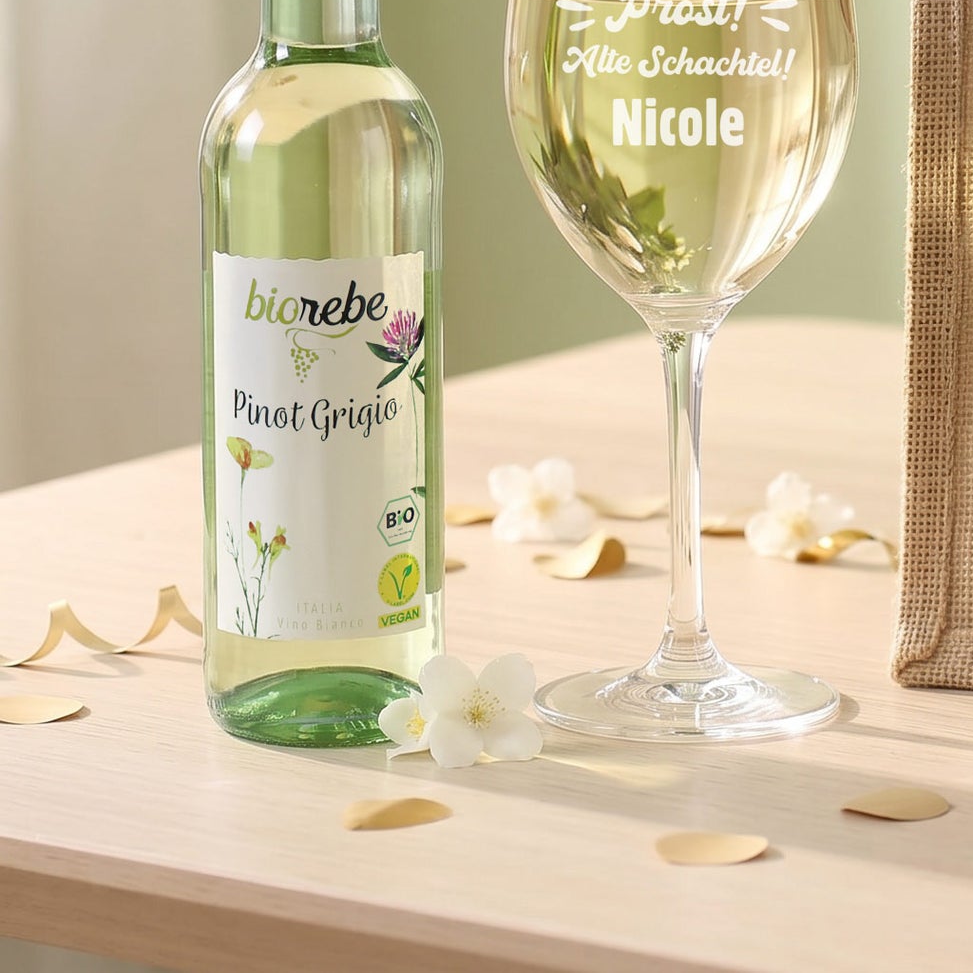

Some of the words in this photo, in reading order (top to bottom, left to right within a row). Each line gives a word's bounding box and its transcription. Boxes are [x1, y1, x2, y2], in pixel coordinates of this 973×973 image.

[562, 44, 632, 78] Alte
[637, 45, 797, 81] Schachtel!
[612, 97, 745, 147] Nicole
[244, 277, 389, 327] biorebe
[233, 388, 305, 432] Pinot
[310, 394, 400, 442] Grigio
[276, 617, 309, 631] Vino
[316, 618, 365, 631] Bianco
[296, 602, 344, 615] ITALIA
[380, 607, 420, 627] VEGAN
